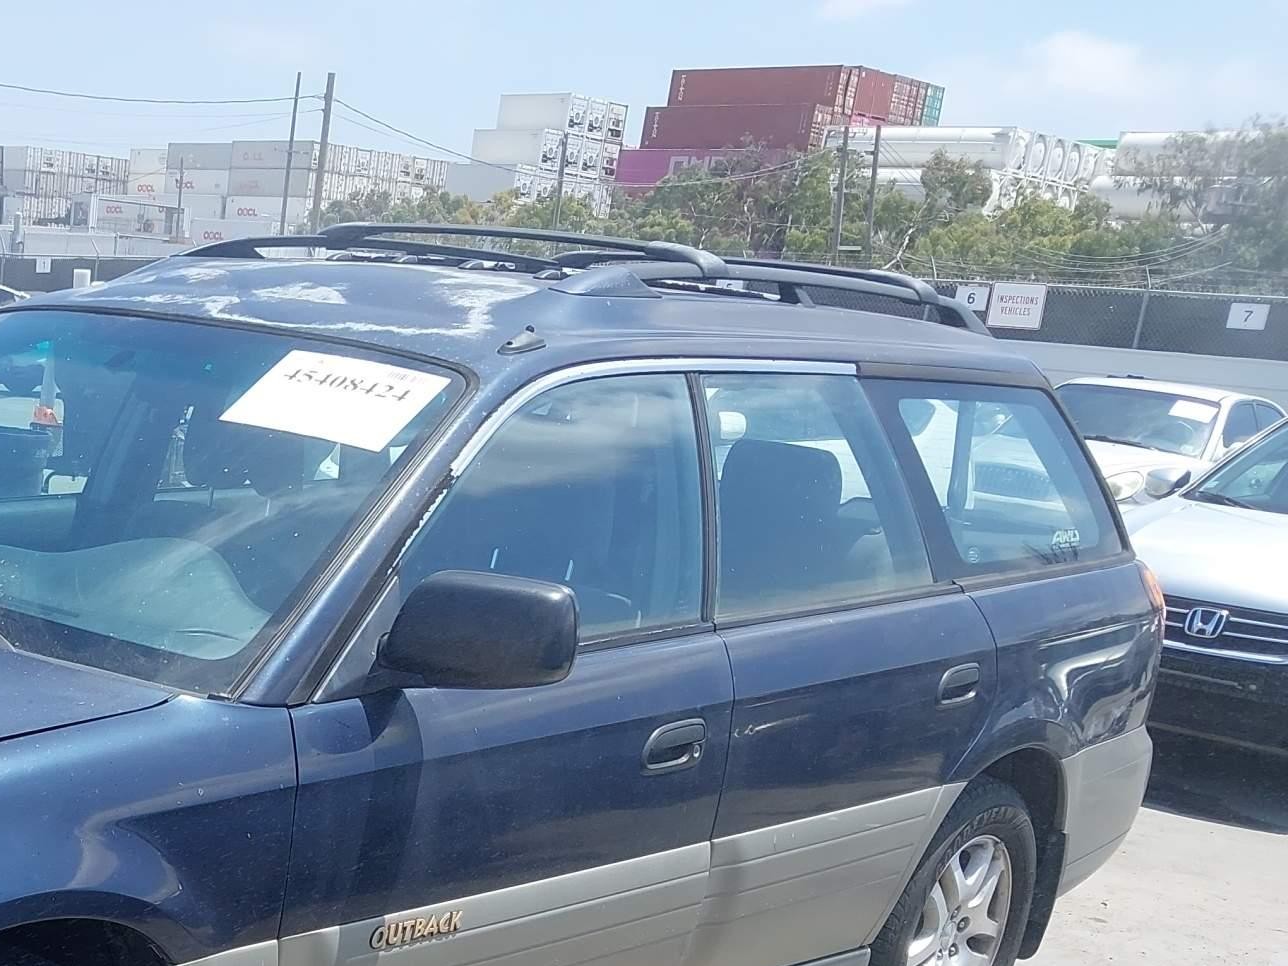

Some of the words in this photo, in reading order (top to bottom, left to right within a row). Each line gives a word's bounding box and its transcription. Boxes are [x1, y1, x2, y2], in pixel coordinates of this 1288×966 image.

[137, 184, 155, 193] OOCL
[105, 205, 123, 214] OOCL
[237, 207, 258, 217] OOCL
[203, 231, 224, 241] OOCL
[967, 292, 976, 304] 6
[997, 295, 1039, 305] INSPECTIONS
[1000, 306, 1031, 316] VEHICLES
[1244, 310, 1254, 322] 7
[283, 367, 412, 402] 45408424
[369, 910, 464, 950] OUTBACK
